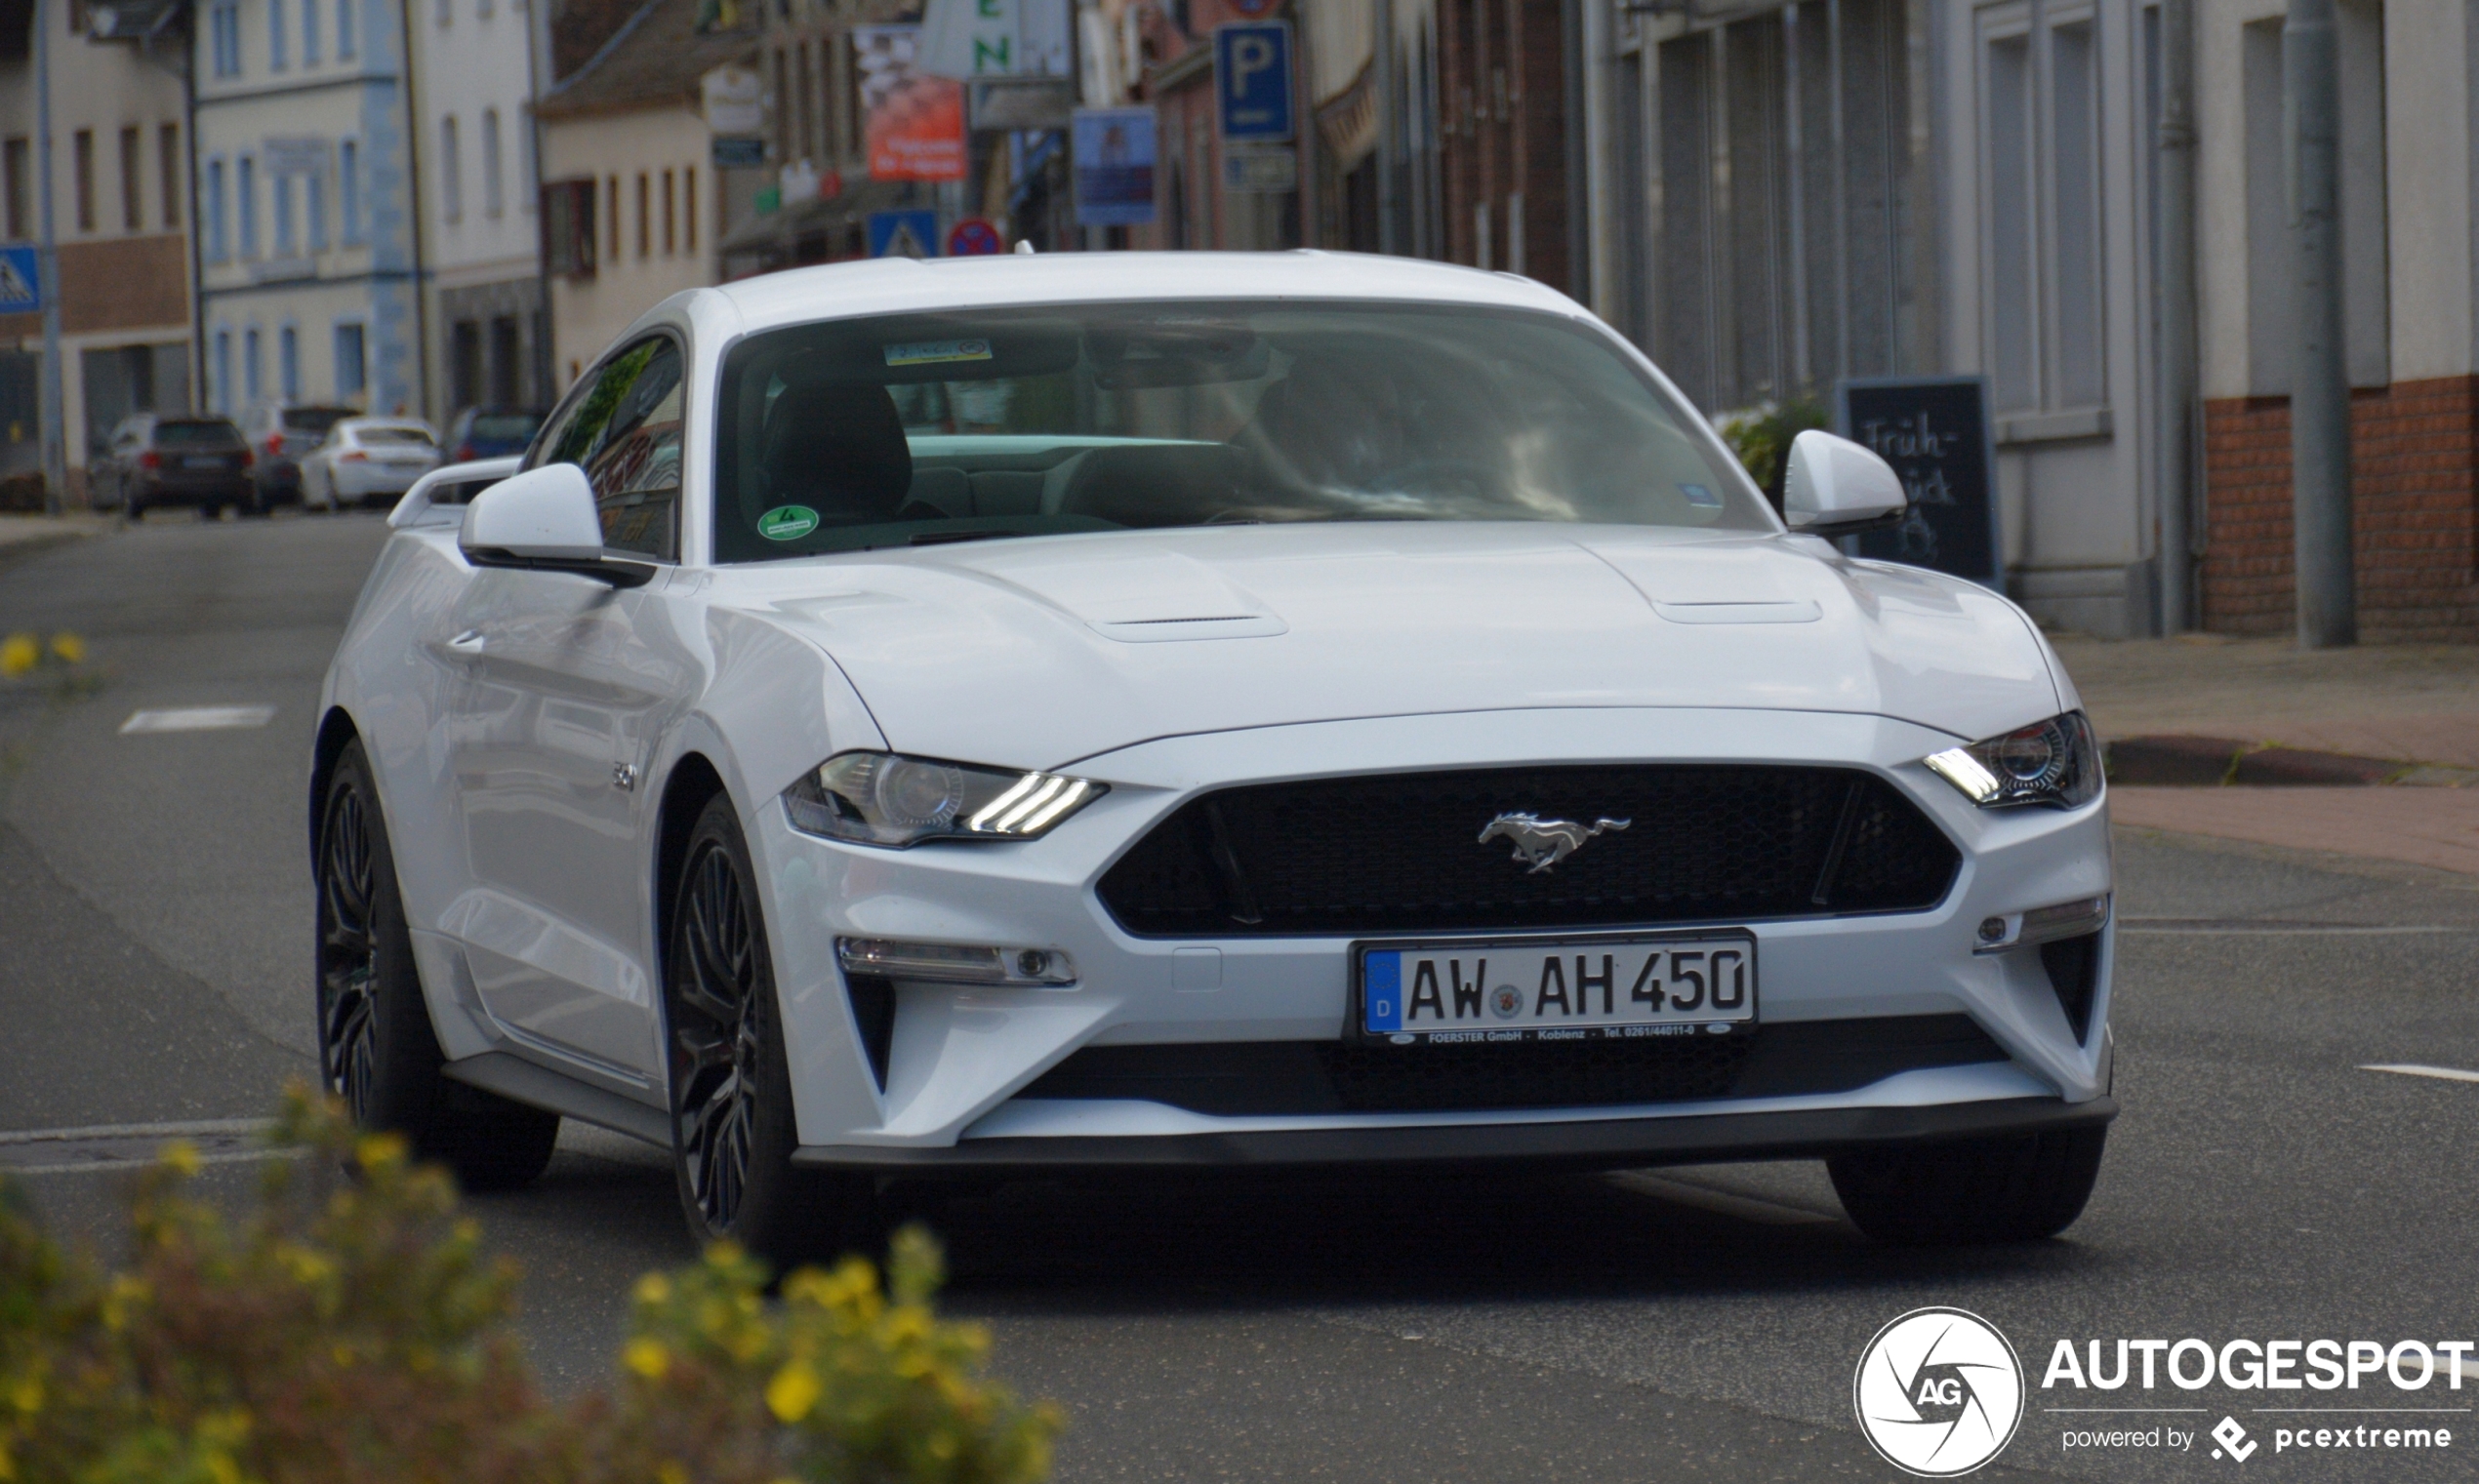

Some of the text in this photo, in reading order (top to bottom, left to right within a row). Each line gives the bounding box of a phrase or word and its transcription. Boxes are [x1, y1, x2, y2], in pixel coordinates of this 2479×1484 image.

[1231, 34, 1274, 100] P
[779, 508, 795, 522] 4
[1407, 950, 1745, 1021] AW AH 450
[1377, 1000, 1390, 1018] D
[1429, 1032, 1484, 1044] FOERSTER
[1486, 1031, 1523, 1042] GmbH
[1537, 1029, 1586, 1040] Koblenz
[1604, 1027, 1621, 1038] Tel.
